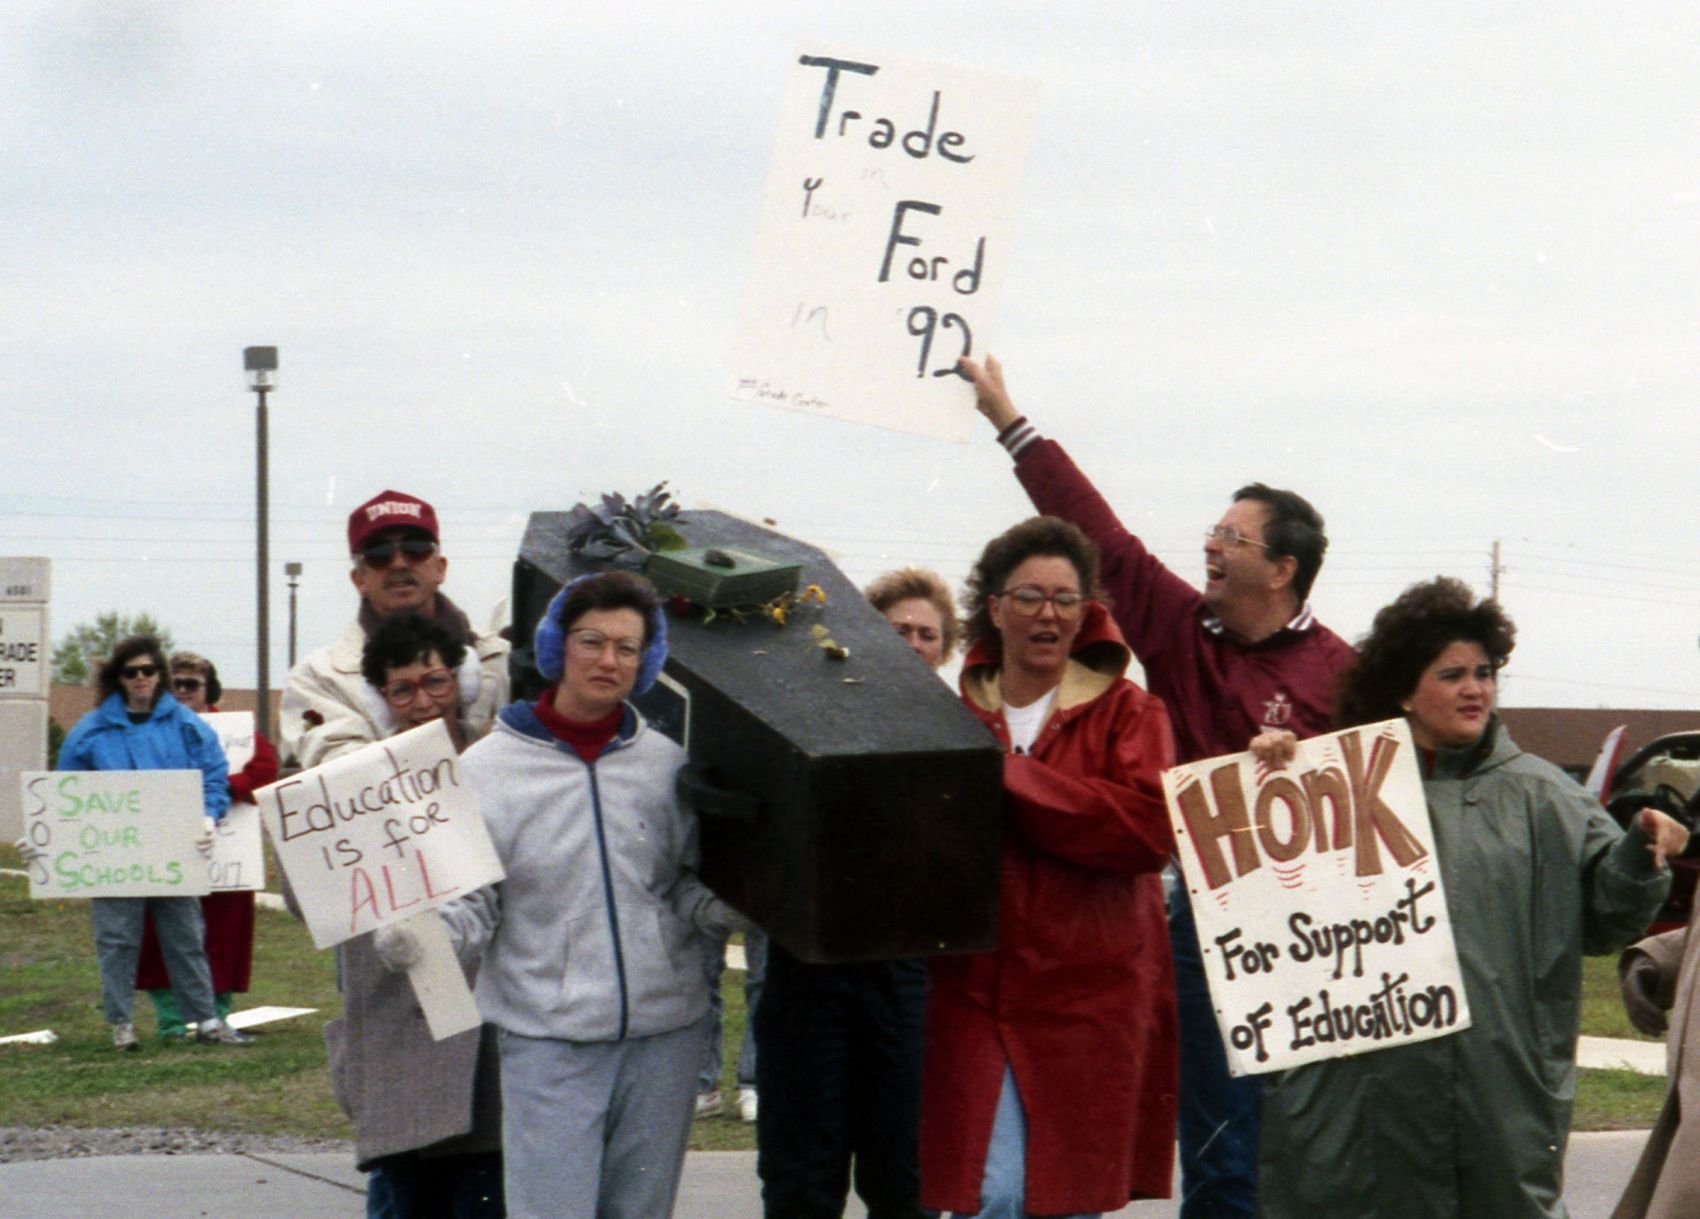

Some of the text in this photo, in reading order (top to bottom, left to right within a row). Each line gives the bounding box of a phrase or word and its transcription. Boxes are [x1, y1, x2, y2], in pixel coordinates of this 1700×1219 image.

[798, 54, 975, 163] Trade
[878, 200, 986, 296] Ford
[365, 500, 422, 522] UNION
[275, 747, 459, 842] Education
[351, 848, 460, 934] ALL
[1215, 877, 1436, 981] For Support
